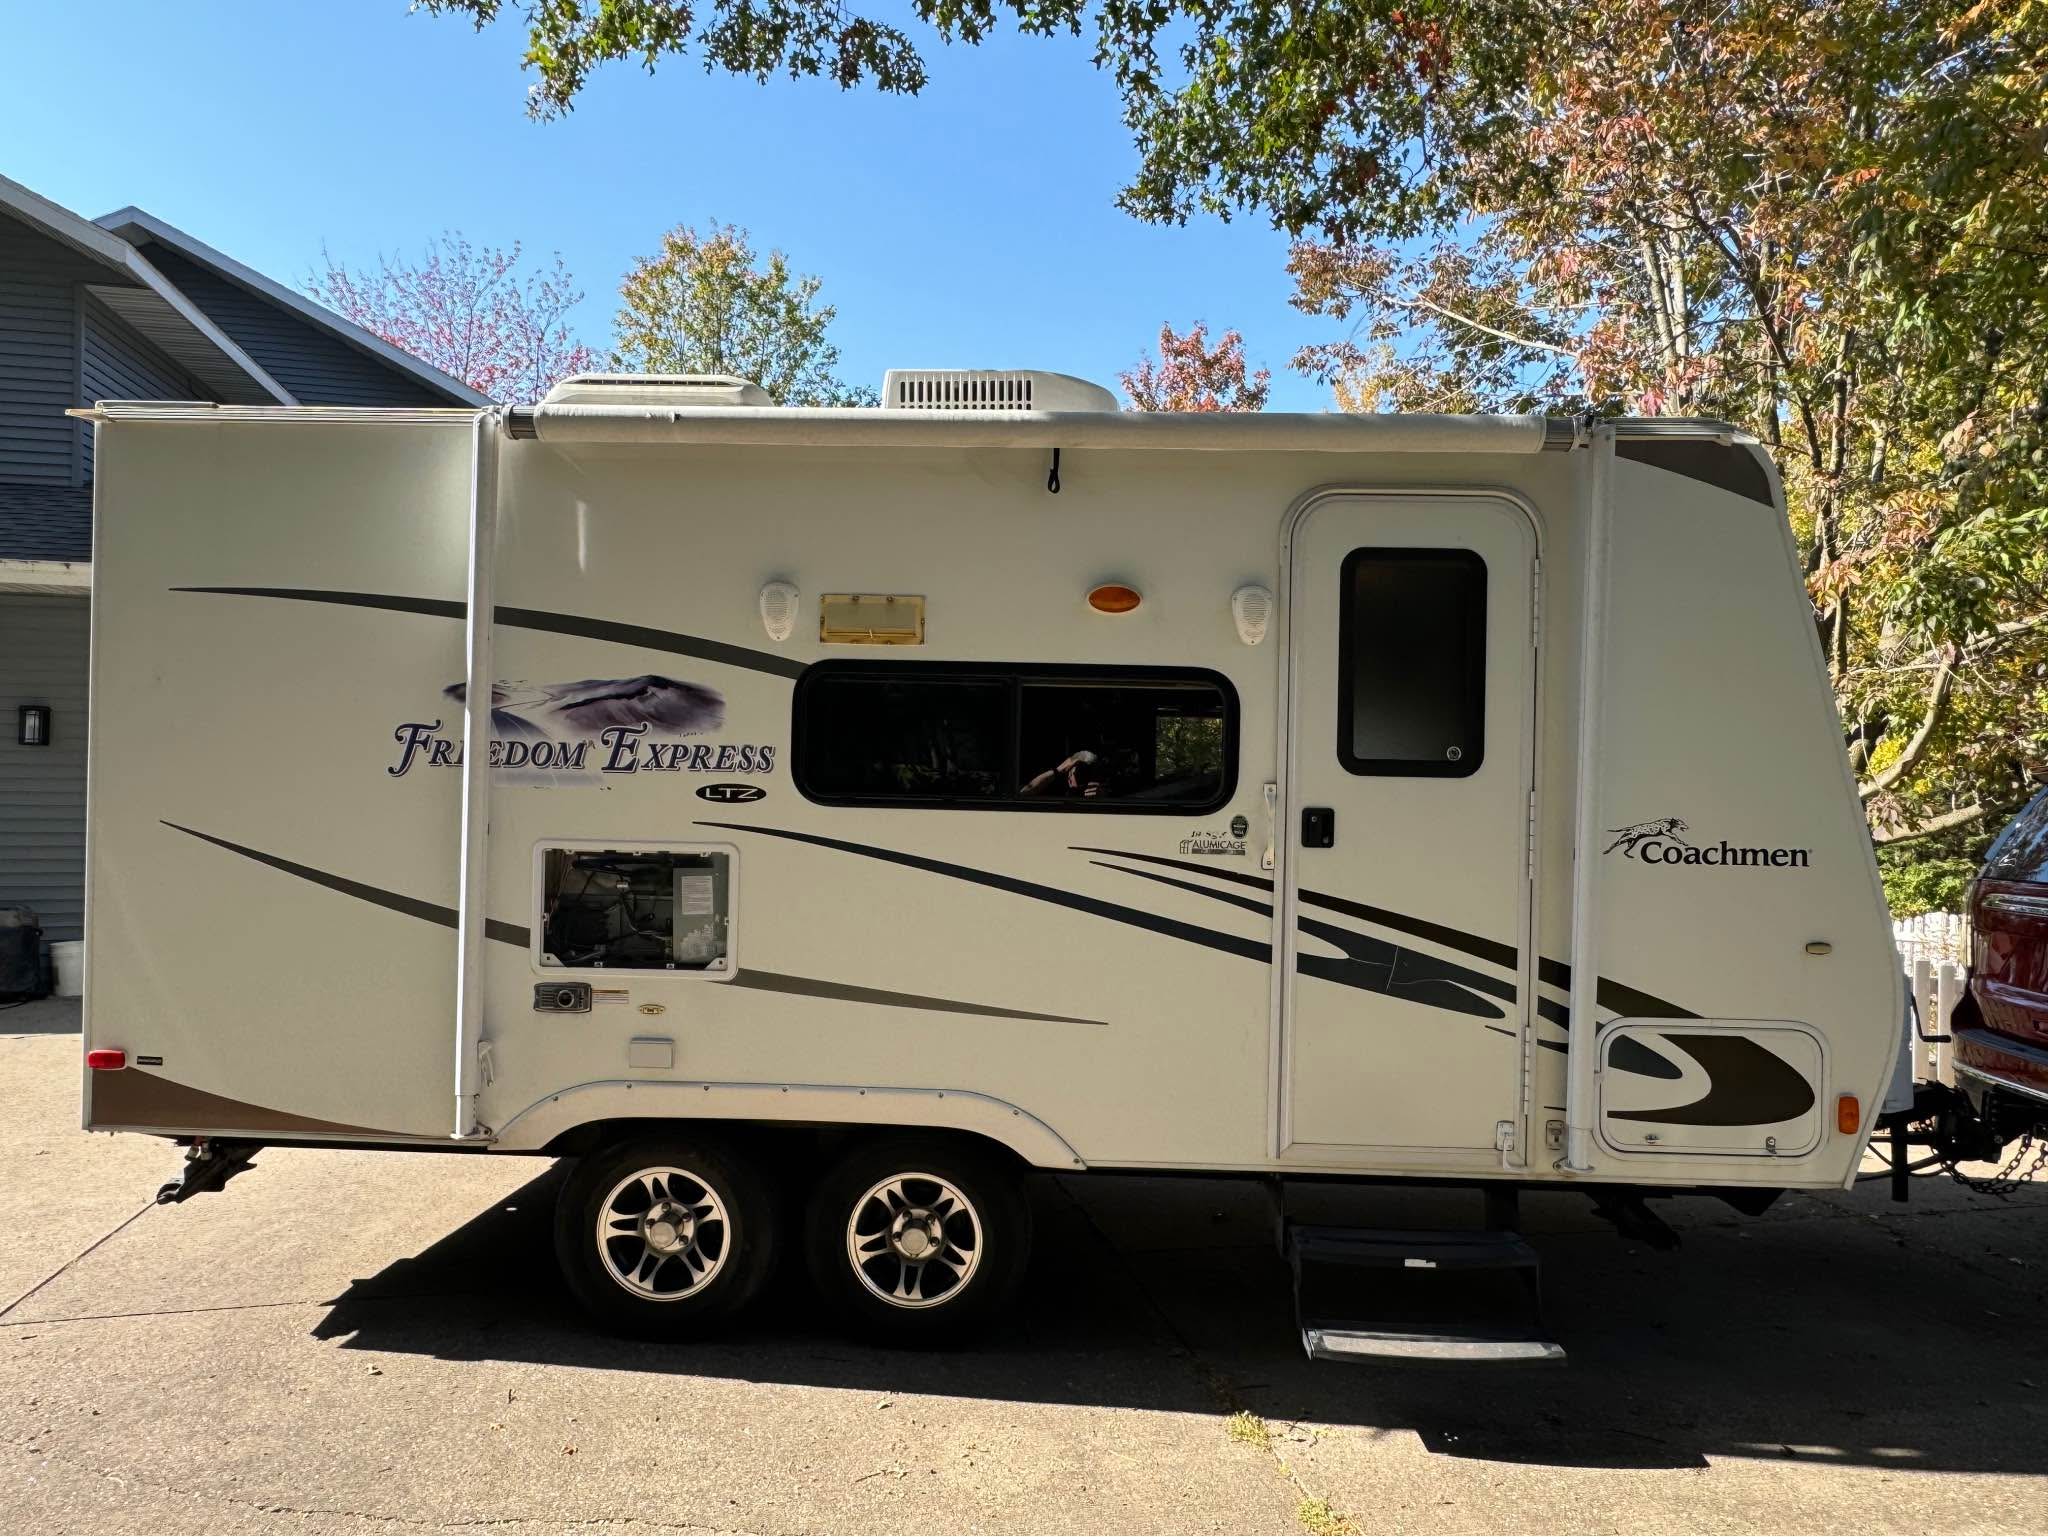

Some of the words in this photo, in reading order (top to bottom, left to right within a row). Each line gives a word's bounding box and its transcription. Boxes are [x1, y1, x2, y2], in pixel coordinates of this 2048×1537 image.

[600, 722, 775, 774] EXPRESS
[705, 787, 758, 799] LTZ
[1192, 840, 1247, 850] ALUMICAGE
[1640, 840, 1810, 867] Coachmen
